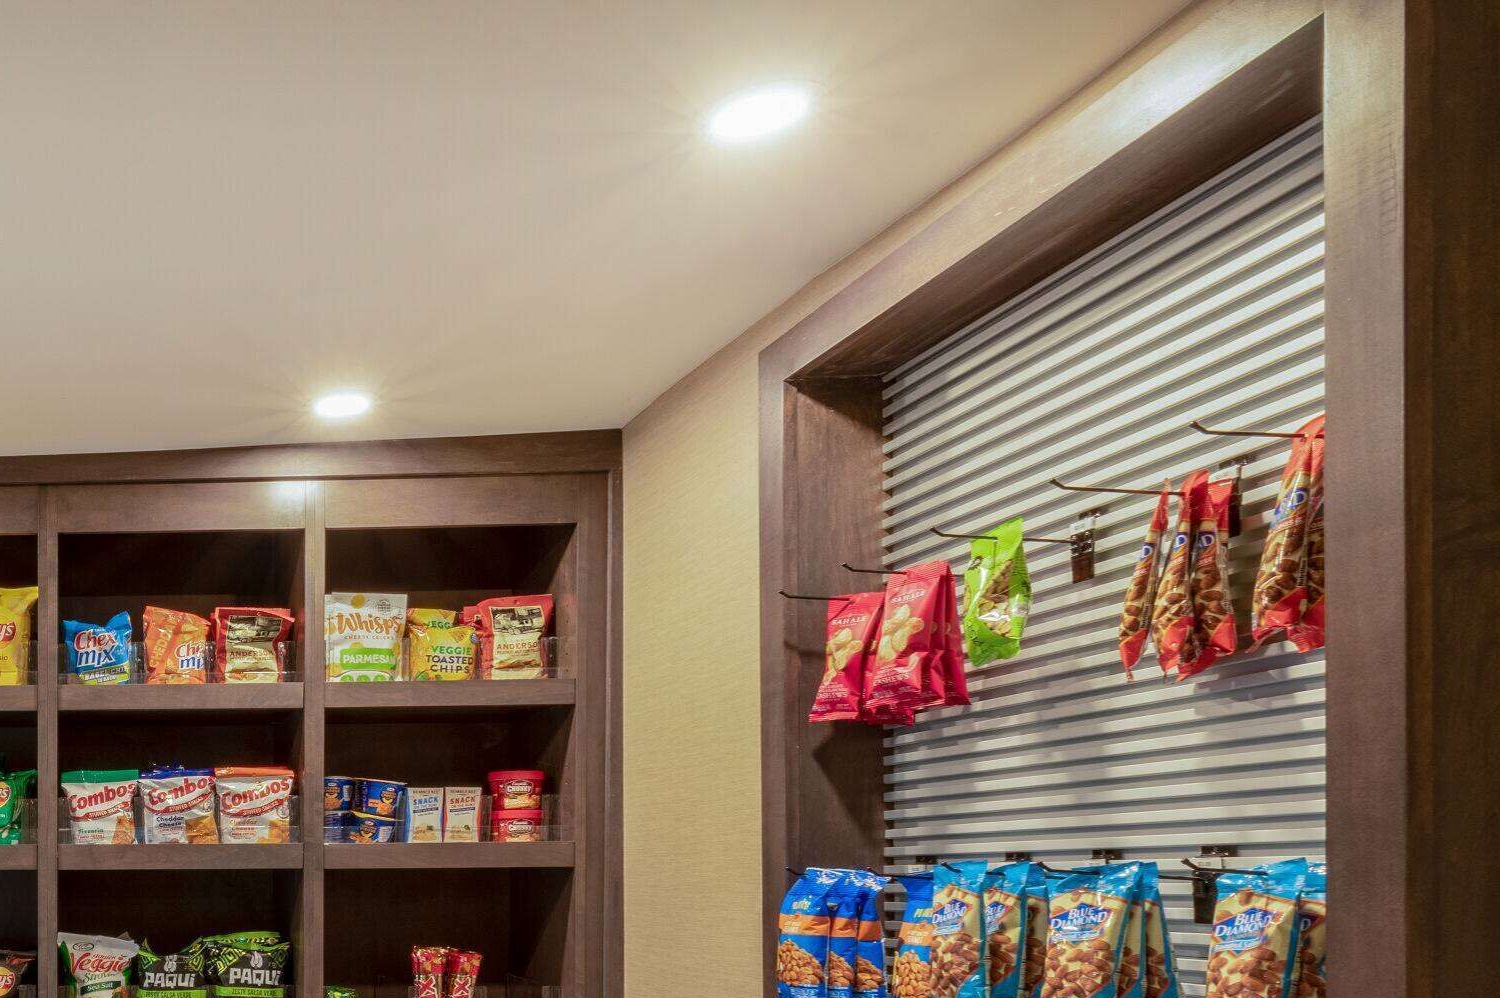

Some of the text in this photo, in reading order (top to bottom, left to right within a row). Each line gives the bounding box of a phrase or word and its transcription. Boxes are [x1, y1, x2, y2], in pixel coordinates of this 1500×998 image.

[75, 629, 116, 651] Chex
[175, 640, 206, 659] Che
[431, 646, 473, 655] VEGGIE
[426, 655, 474, 665] TOASTED
[430, 664, 470, 674] CHIPS
[68, 783, 137, 812] Combos
[413, 797, 439, 805] SNACK
[450, 796, 476, 804] SNACK
